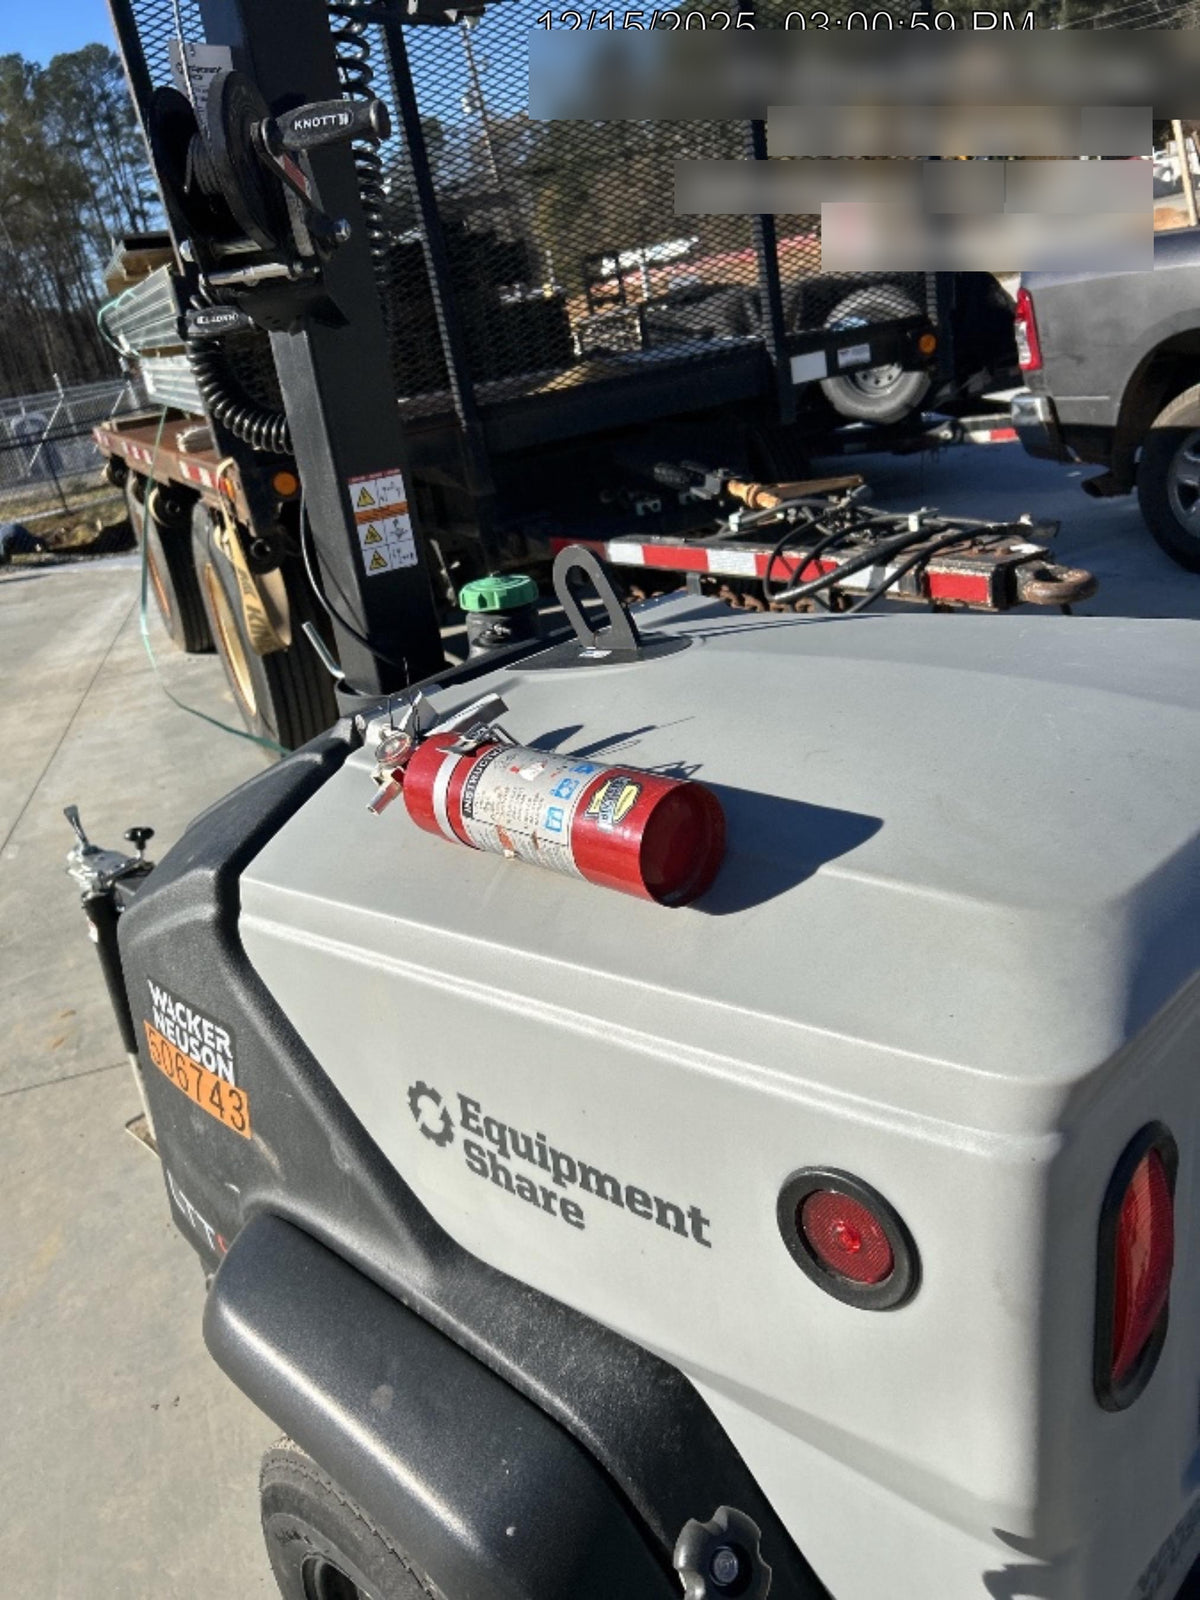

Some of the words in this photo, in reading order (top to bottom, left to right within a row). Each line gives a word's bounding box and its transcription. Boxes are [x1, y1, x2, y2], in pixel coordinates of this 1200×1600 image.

[294, 113, 338, 131] KNOTT
[147, 979, 234, 1060] WACKER
[152, 1005, 236, 1088] NEUSON
[148, 1030, 246, 1132] 506743
[456, 1091, 712, 1248] Equipment
[462, 1138, 586, 1231] Share
